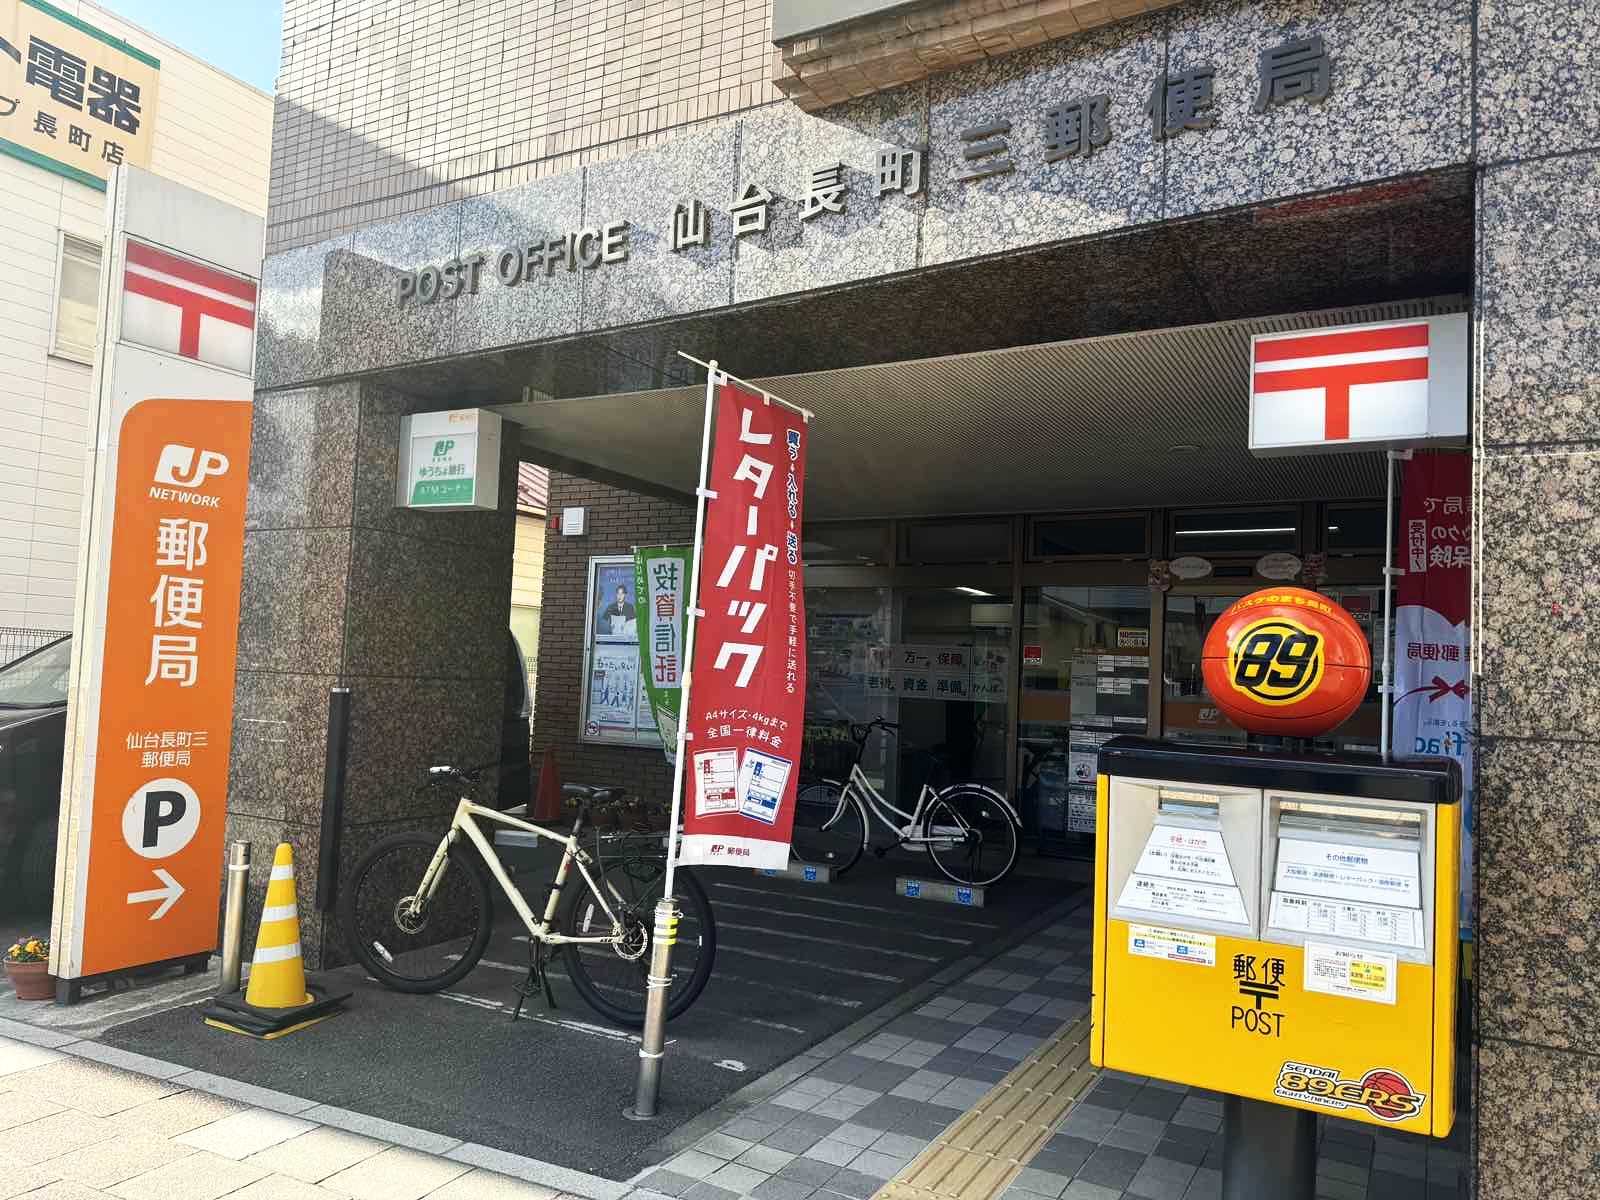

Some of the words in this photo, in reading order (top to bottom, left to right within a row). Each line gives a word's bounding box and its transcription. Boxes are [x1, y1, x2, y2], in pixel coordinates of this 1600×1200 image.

[395, 252, 485, 304] POST
[498, 217, 630, 288] OFFICE
[667, 35, 1332, 252] 仙台長町三郵便局
[154, 444, 230, 488] JP
[149, 487, 222, 508] NETWORK
[786, 473, 800, 519] 入れる
[713, 407, 779, 689] レターパック
[786, 530, 799, 566] 送る
[145, 517, 210, 688] 郵便局
[1234, 633, 1319, 688] 89
[126, 731, 209, 750] 仙台長町三
[706, 724, 784, 749] 全国一律料金
[141, 751, 192, 768] 郵便局
[142, 790, 188, 848] P
[727, 846, 751, 858] 郵便局
[1232, 953, 1285, 987] 郵便
[1231, 1005, 1286, 1038] POST
[1285, 1063, 1337, 1079] SENDAI
[1280, 1071, 1421, 1115] 89ERS
